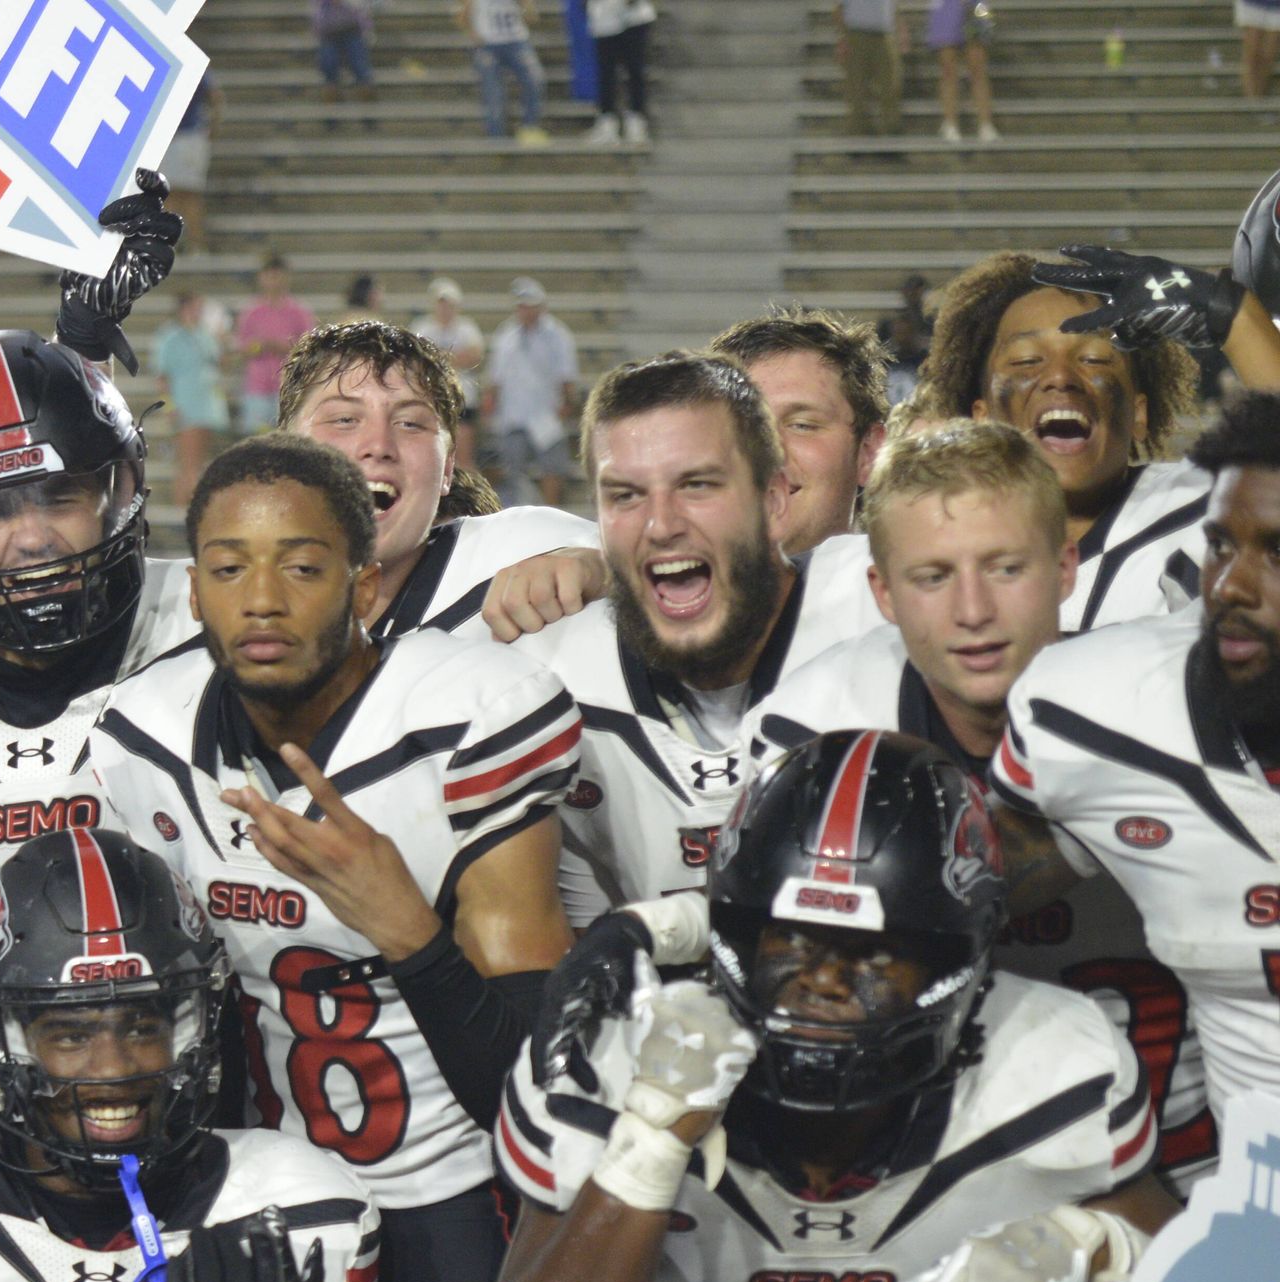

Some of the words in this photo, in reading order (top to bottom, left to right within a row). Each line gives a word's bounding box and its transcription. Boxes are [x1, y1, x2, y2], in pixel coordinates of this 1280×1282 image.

[208, 879, 307, 928] SEMO
[796, 887, 861, 913] SEMO
[71, 959, 142, 982] SEMO
[240, 945, 412, 1166] 8
[1058, 957, 1222, 1172] 2
